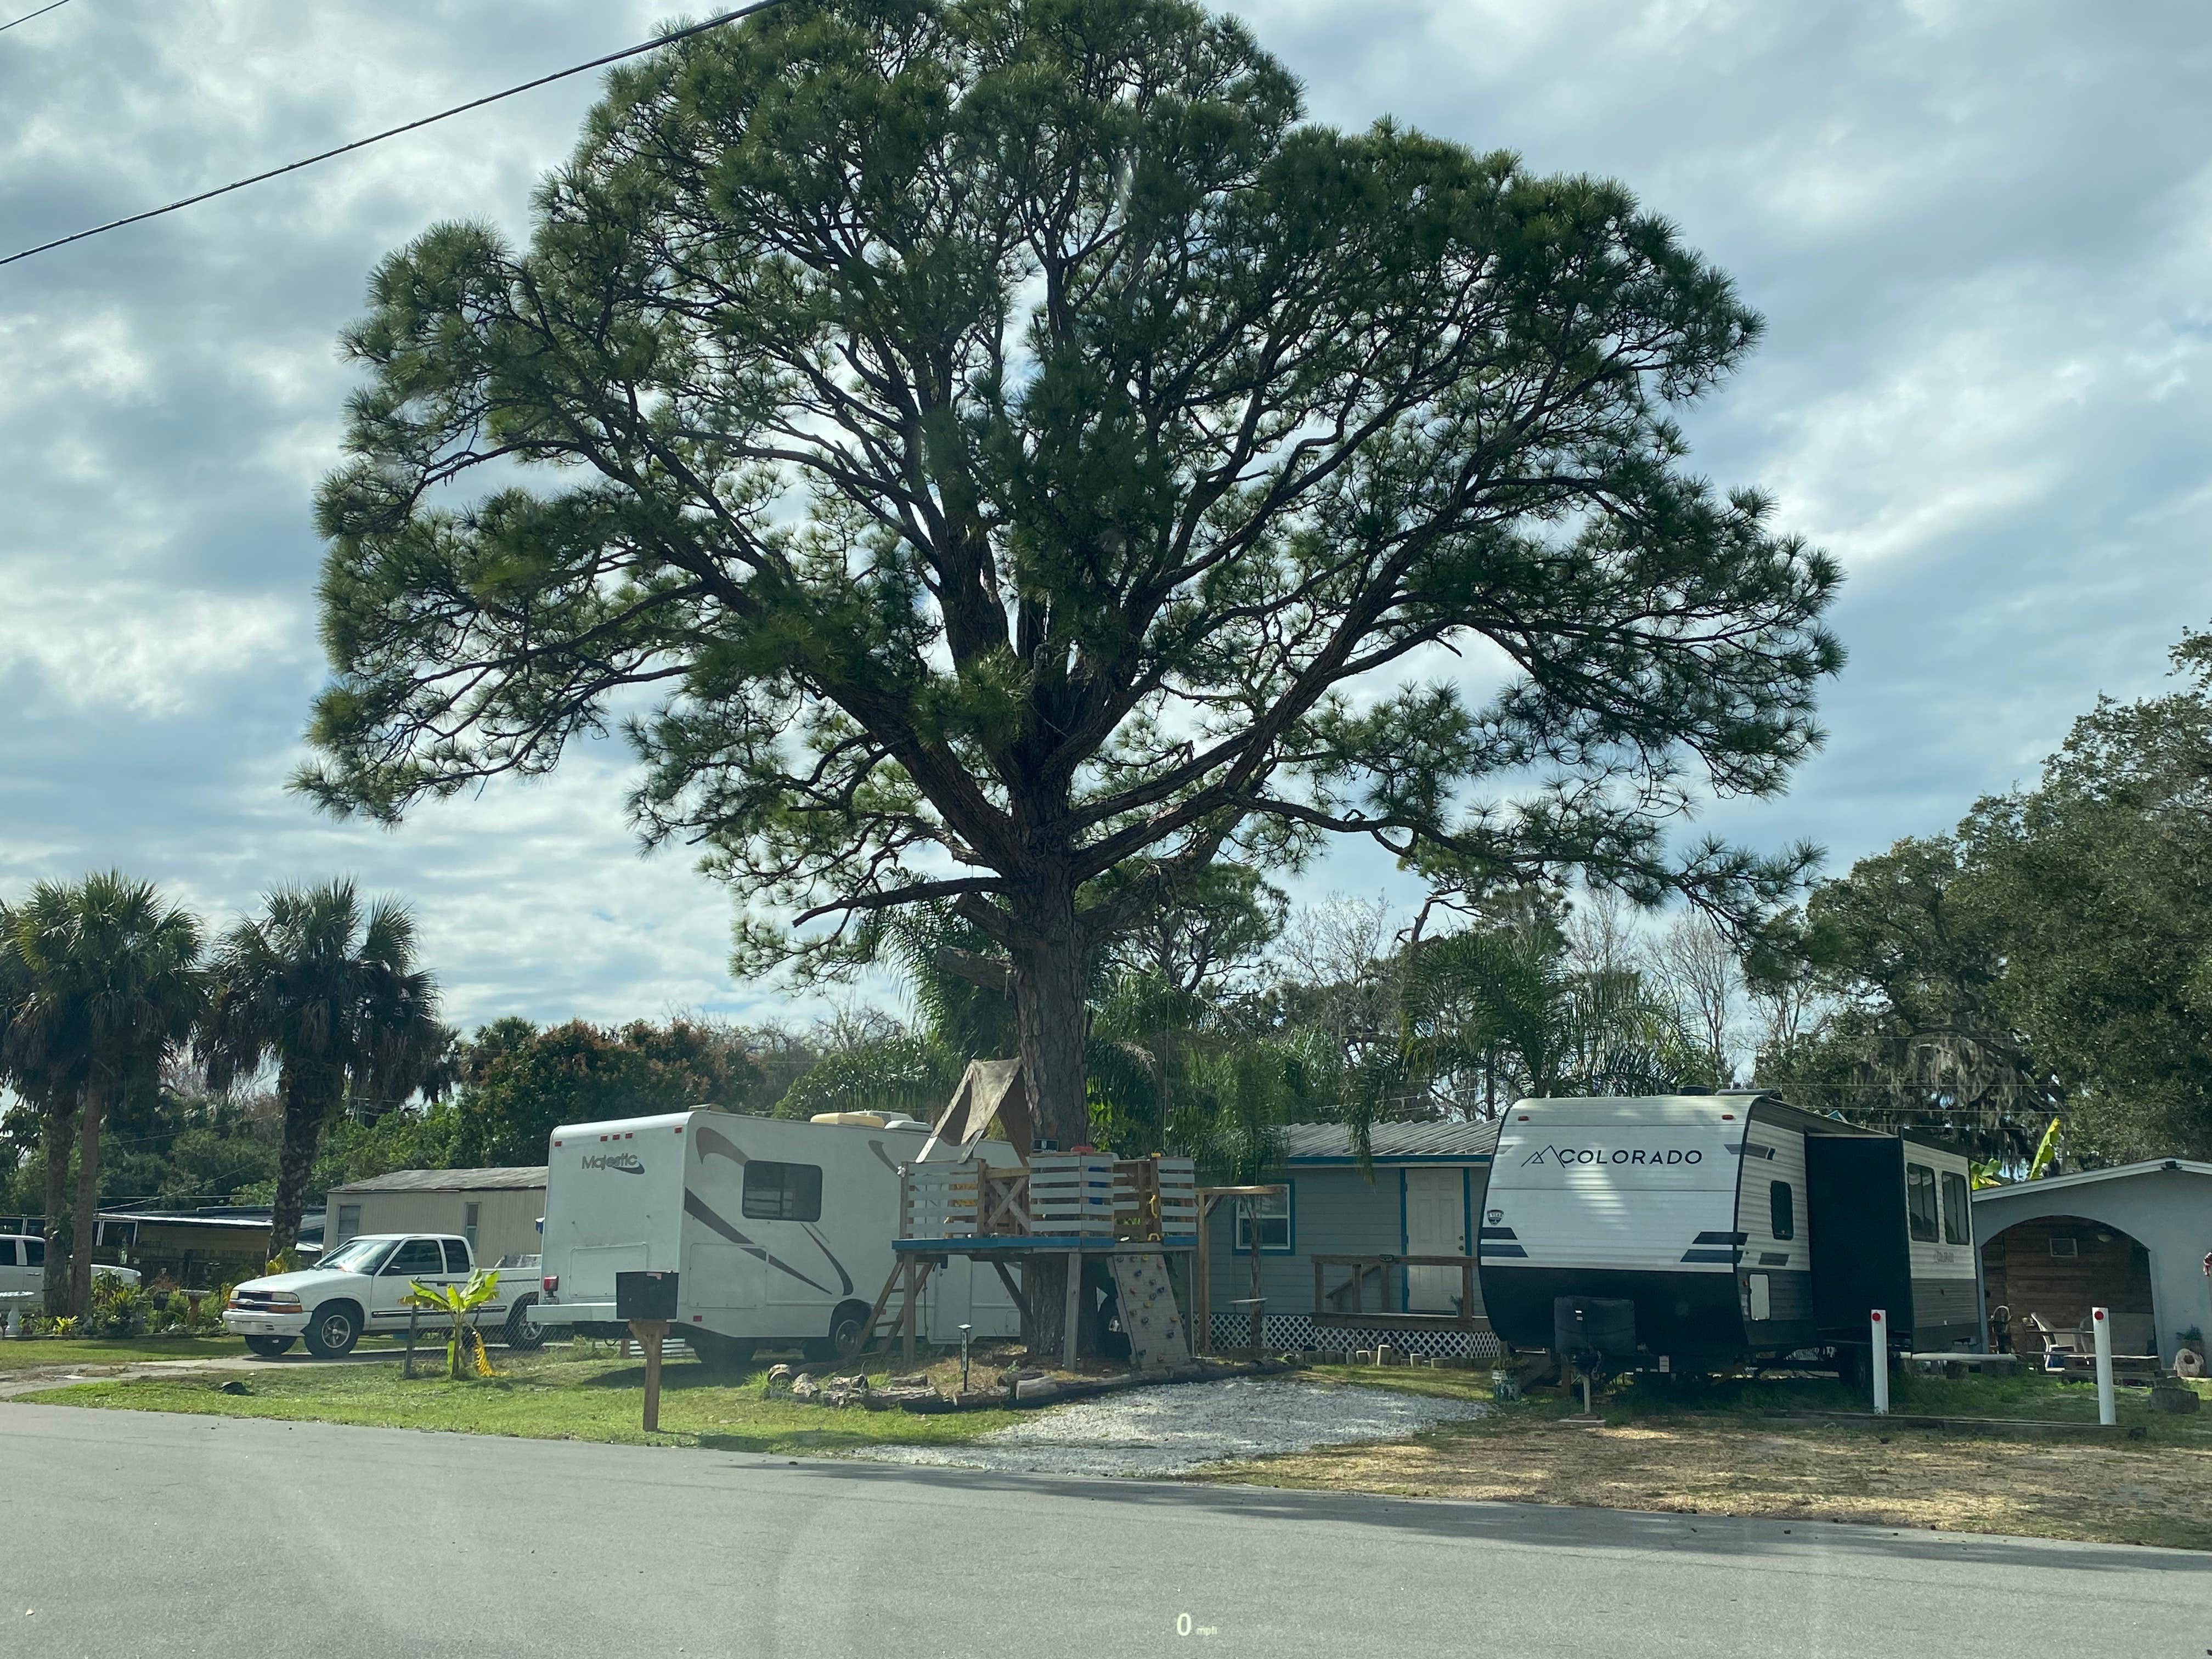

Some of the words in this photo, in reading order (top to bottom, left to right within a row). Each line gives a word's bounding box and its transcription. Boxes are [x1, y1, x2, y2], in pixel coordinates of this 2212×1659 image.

[582, 1153, 637, 1170] Majestic
[1559, 1148, 1702, 1165] COLORADO
[1177, 1613, 1191, 1636] 0
[1197, 1626, 1217, 1636] mph
